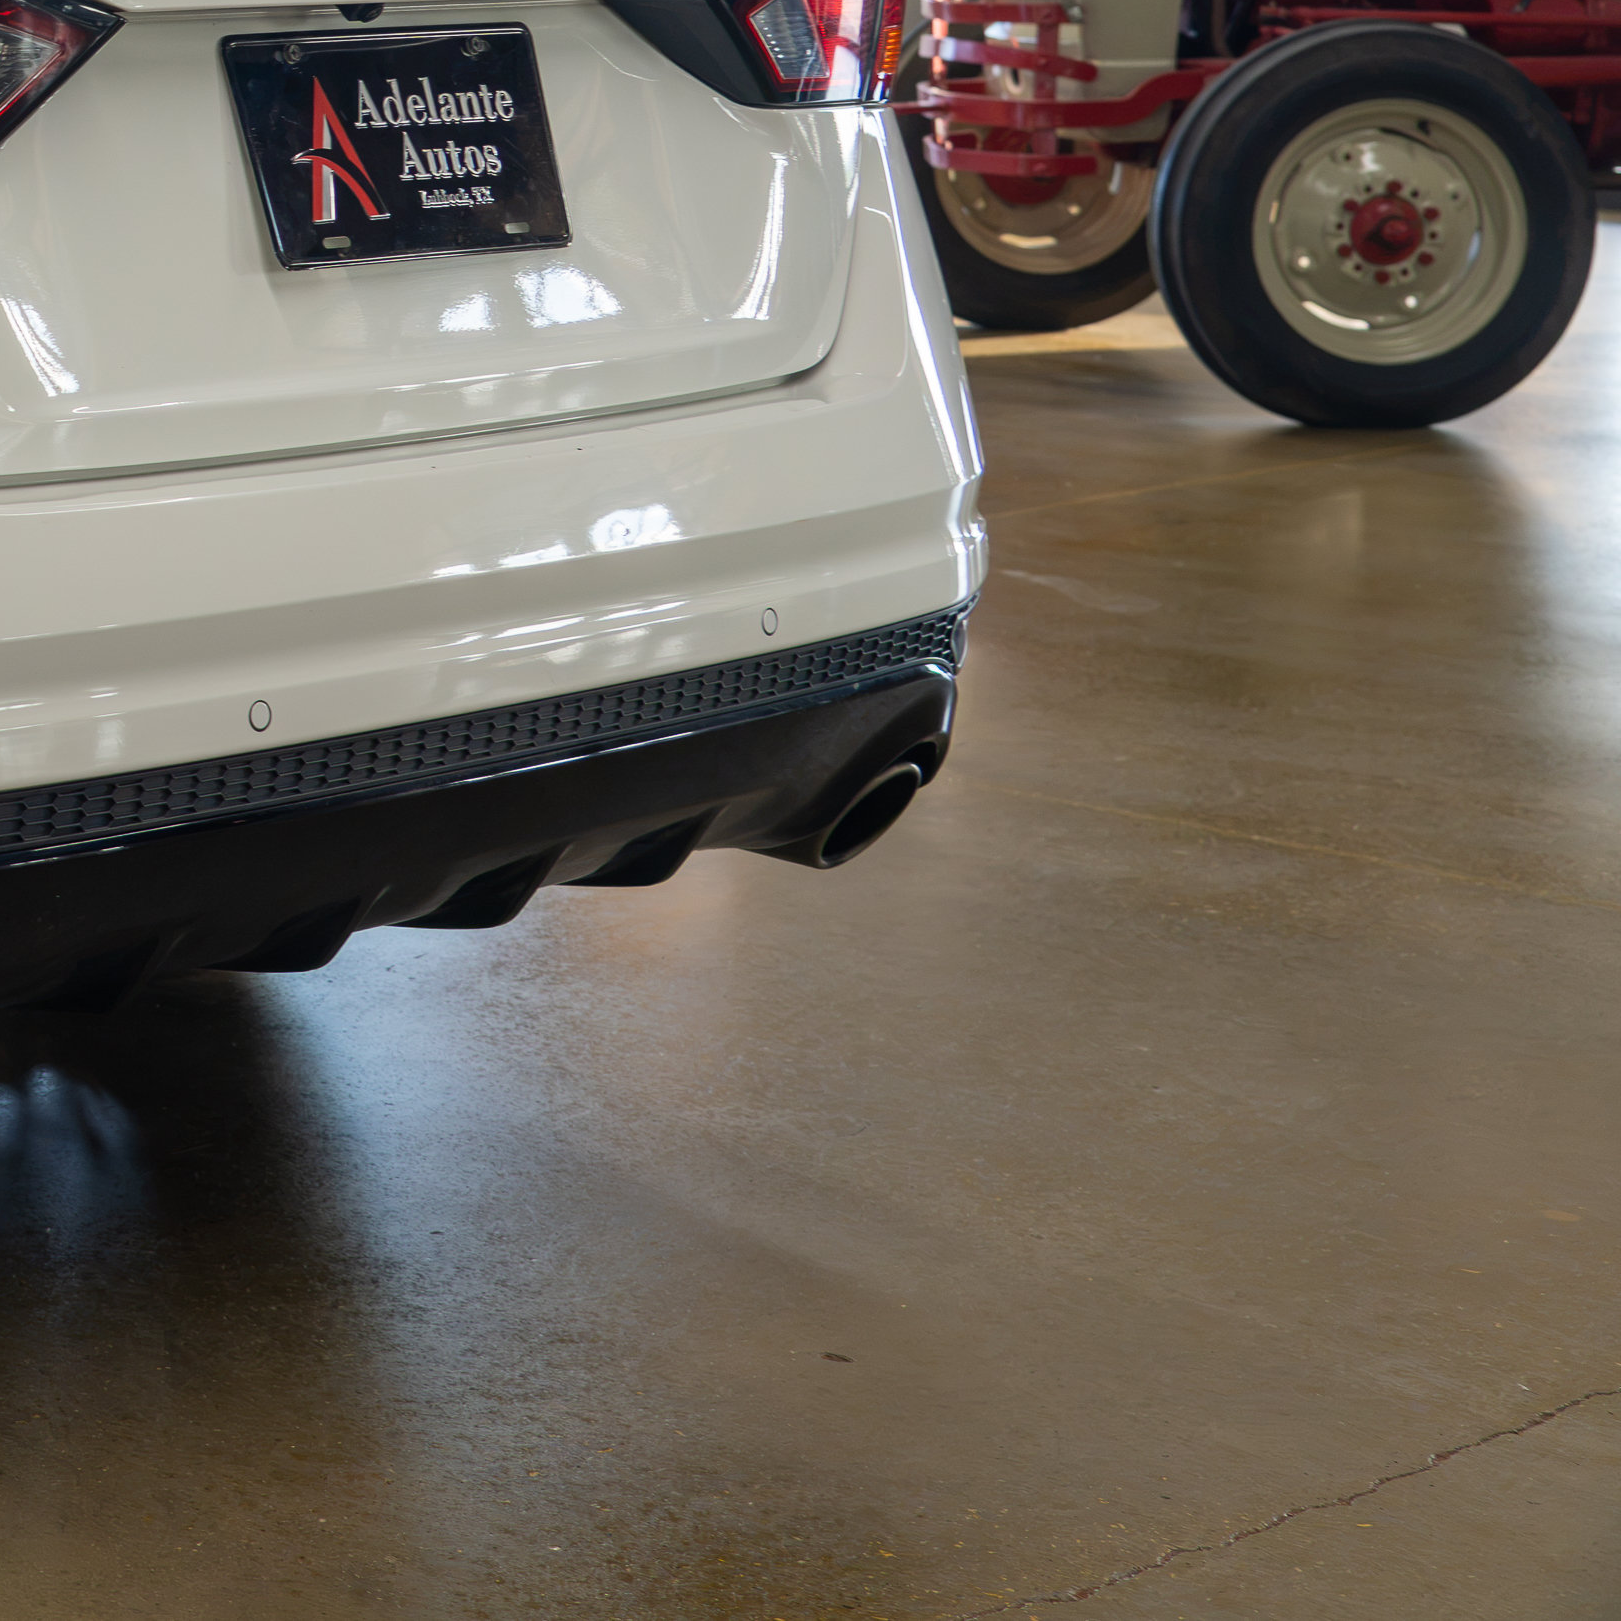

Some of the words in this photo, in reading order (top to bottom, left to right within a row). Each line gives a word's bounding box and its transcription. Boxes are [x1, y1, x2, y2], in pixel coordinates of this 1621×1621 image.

[354, 76, 515, 129] Adelante
[398, 131, 503, 181] Autos
[470, 185, 496, 205] TX
